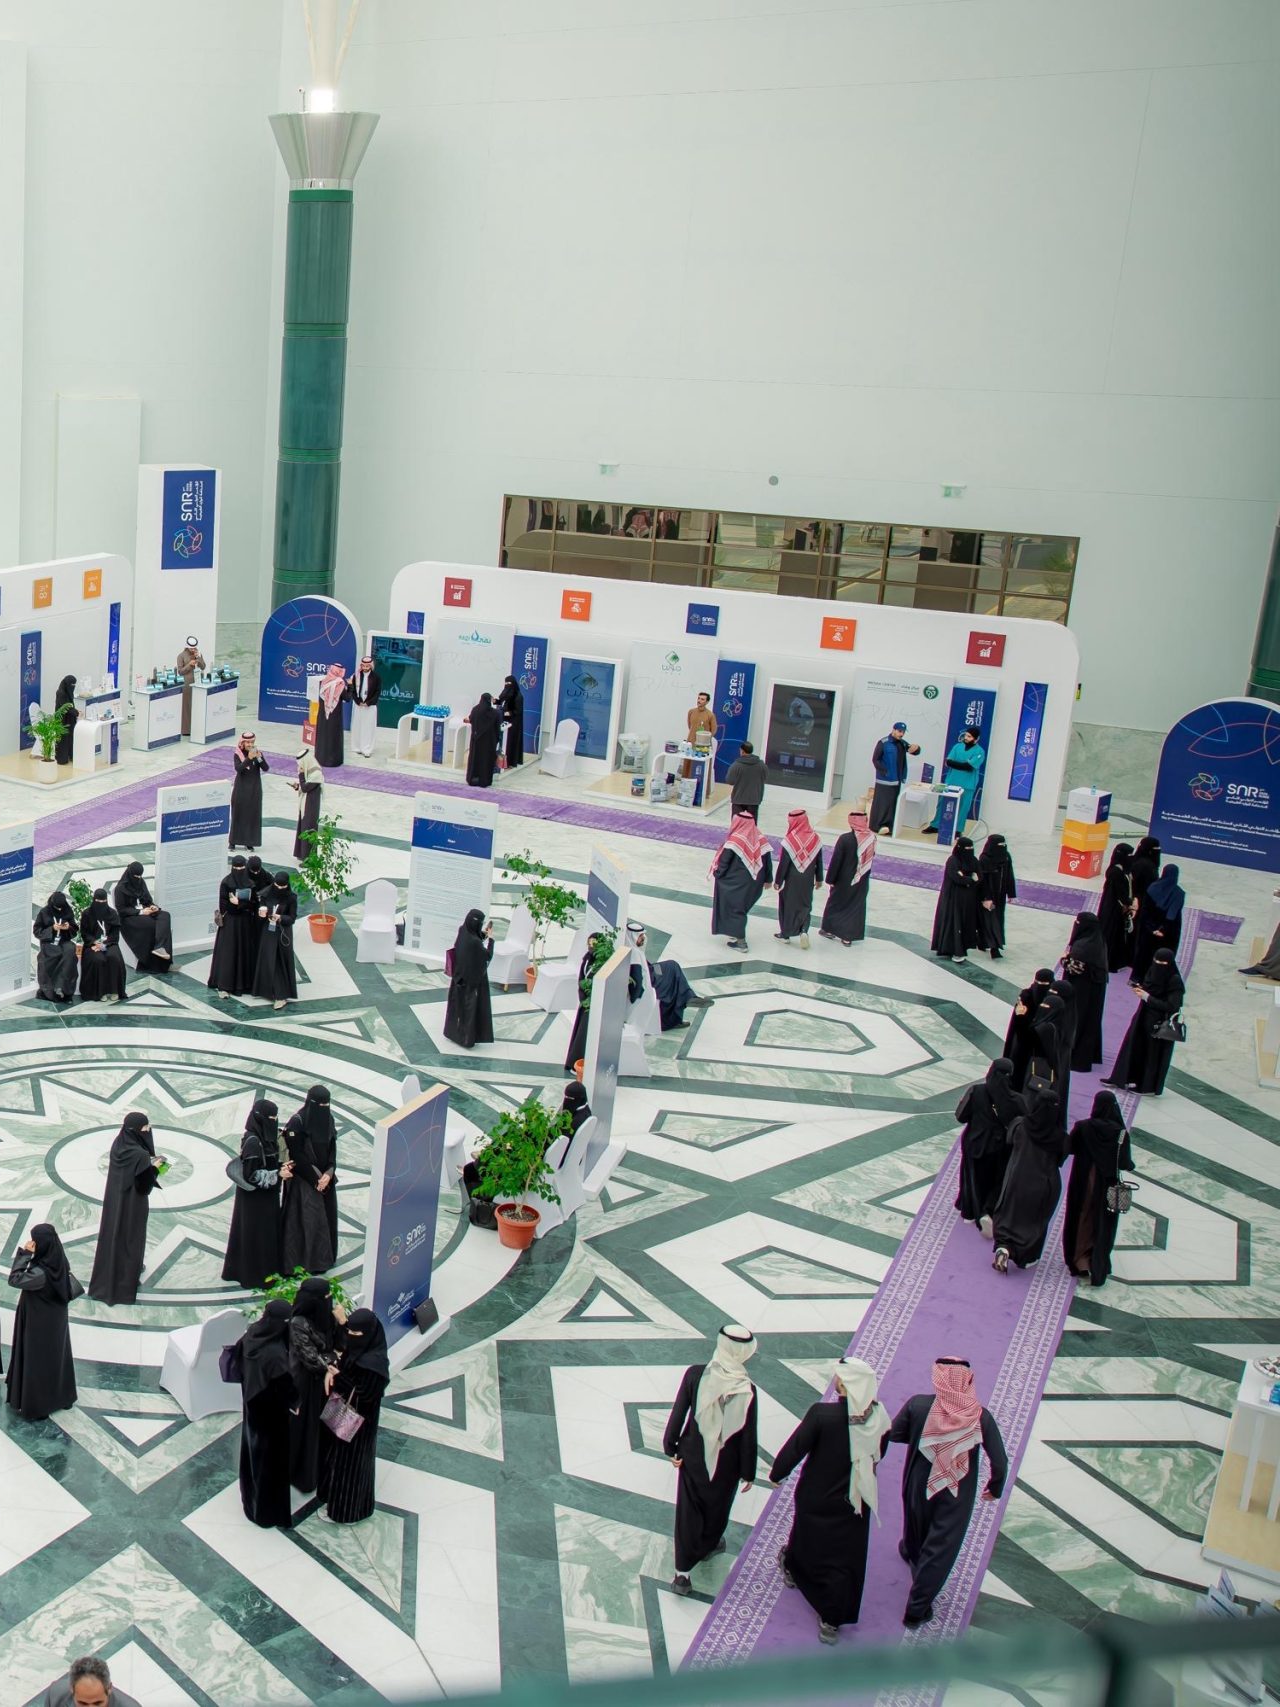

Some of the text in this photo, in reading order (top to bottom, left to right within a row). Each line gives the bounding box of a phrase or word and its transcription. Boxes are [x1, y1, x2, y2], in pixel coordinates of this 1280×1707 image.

[181, 492, 193, 522] SNR
[306, 662, 326, 672] SNR
[524, 652, 532, 670] SNR
[729, 678, 738, 696] SNR
[966, 706, 976, 726] SNR
[1227, 784, 1258, 798] SNR
[406, 1224, 422, 1245] SNR
